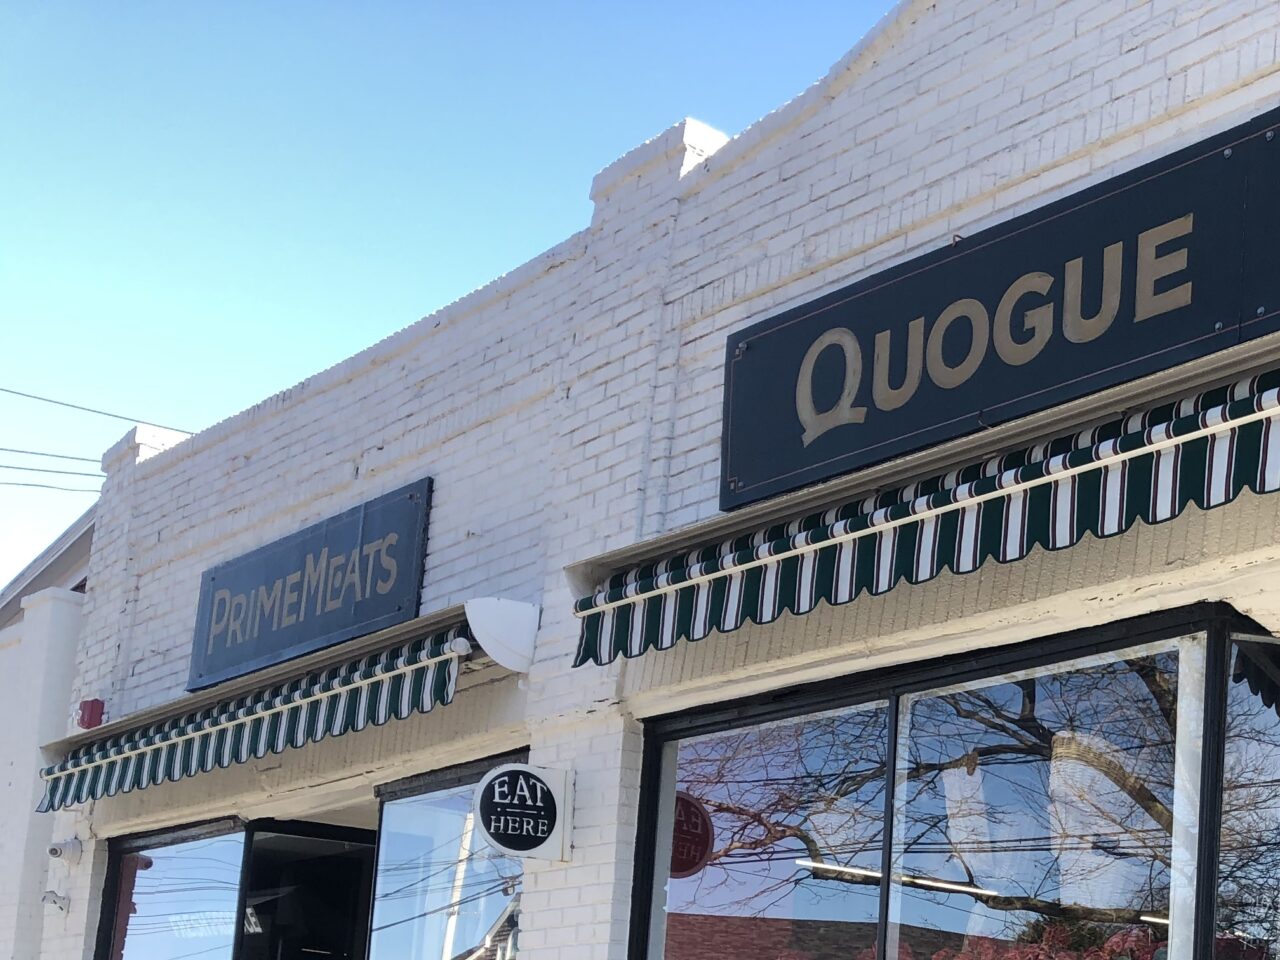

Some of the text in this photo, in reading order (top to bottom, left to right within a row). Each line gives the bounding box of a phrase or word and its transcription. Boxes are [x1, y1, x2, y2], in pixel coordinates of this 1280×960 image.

[795, 212, 1194, 448] QUOGUE
[491, 774, 547, 807] EAT
[489, 815, 549, 837] HERE
